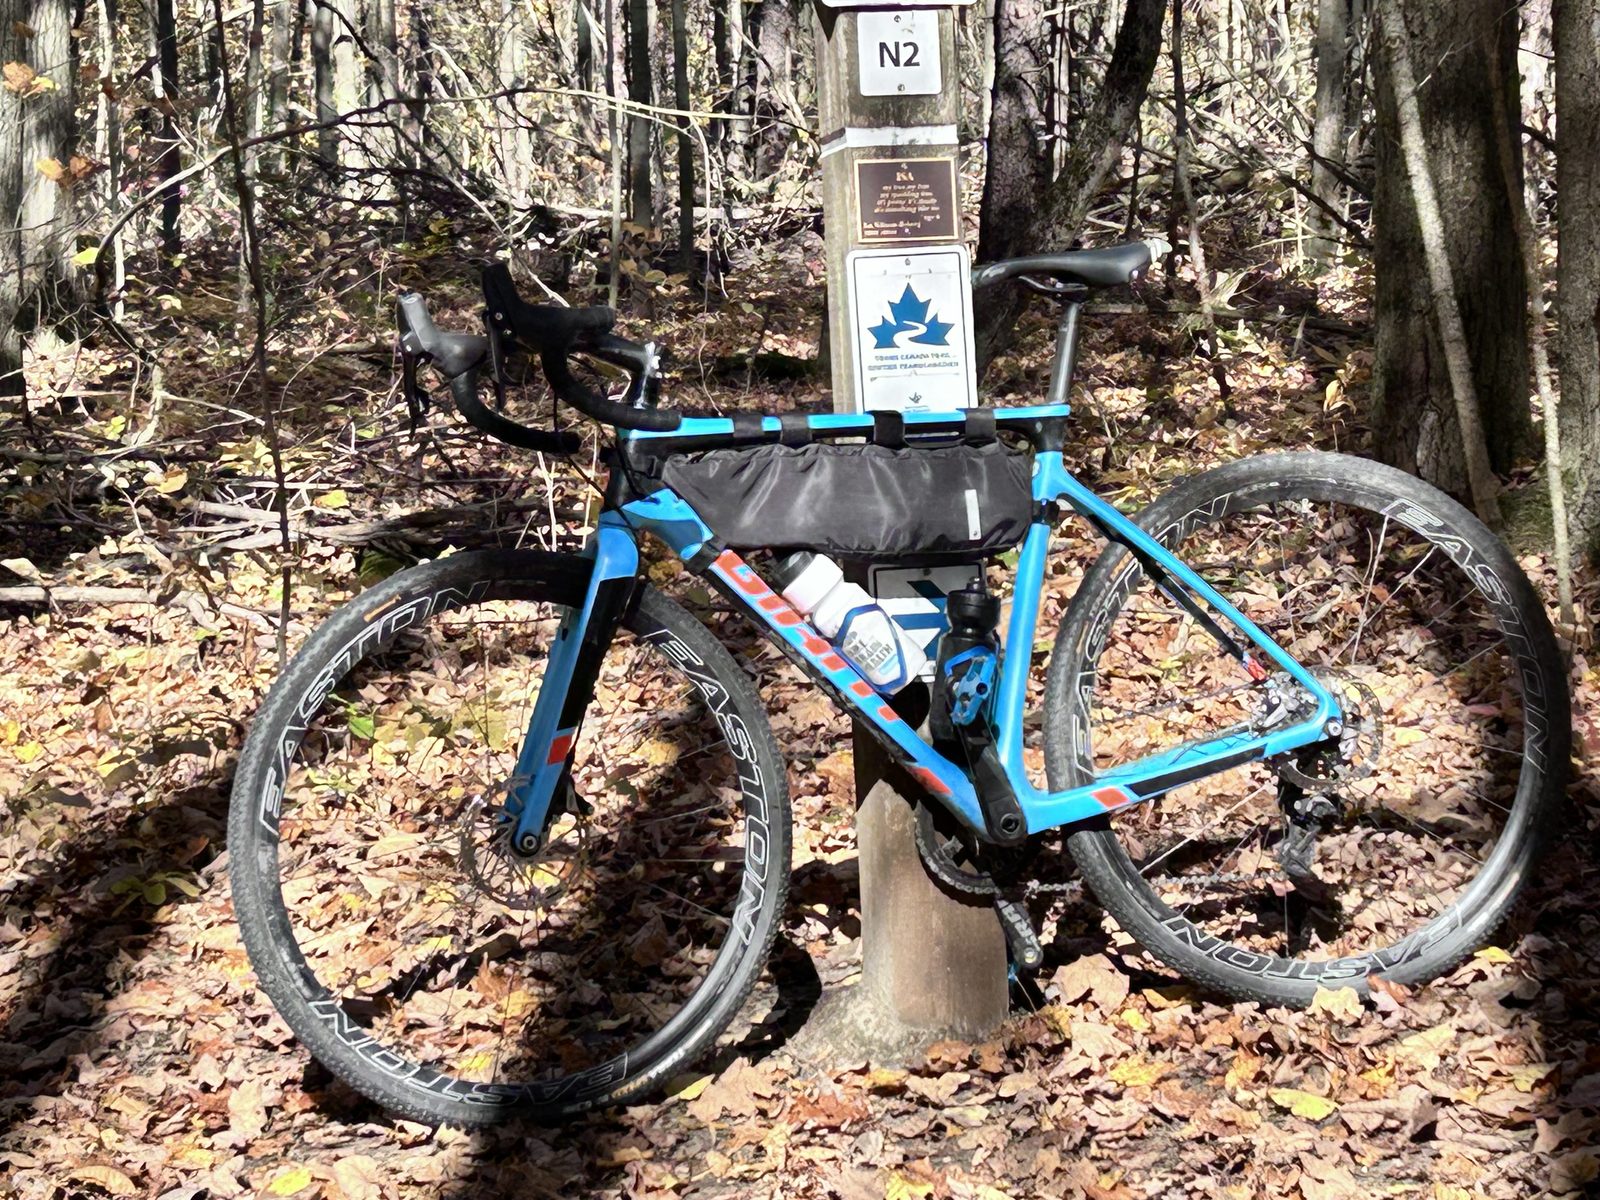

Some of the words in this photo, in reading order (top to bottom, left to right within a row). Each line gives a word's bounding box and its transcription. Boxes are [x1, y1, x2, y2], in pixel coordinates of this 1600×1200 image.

[879, 41, 920, 67] N2
[259, 580, 491, 836] EASTON
[1380, 498, 1549, 775] EASTON
[643, 629, 770, 946] EASTON
[308, 999, 629, 1105] EASTON
